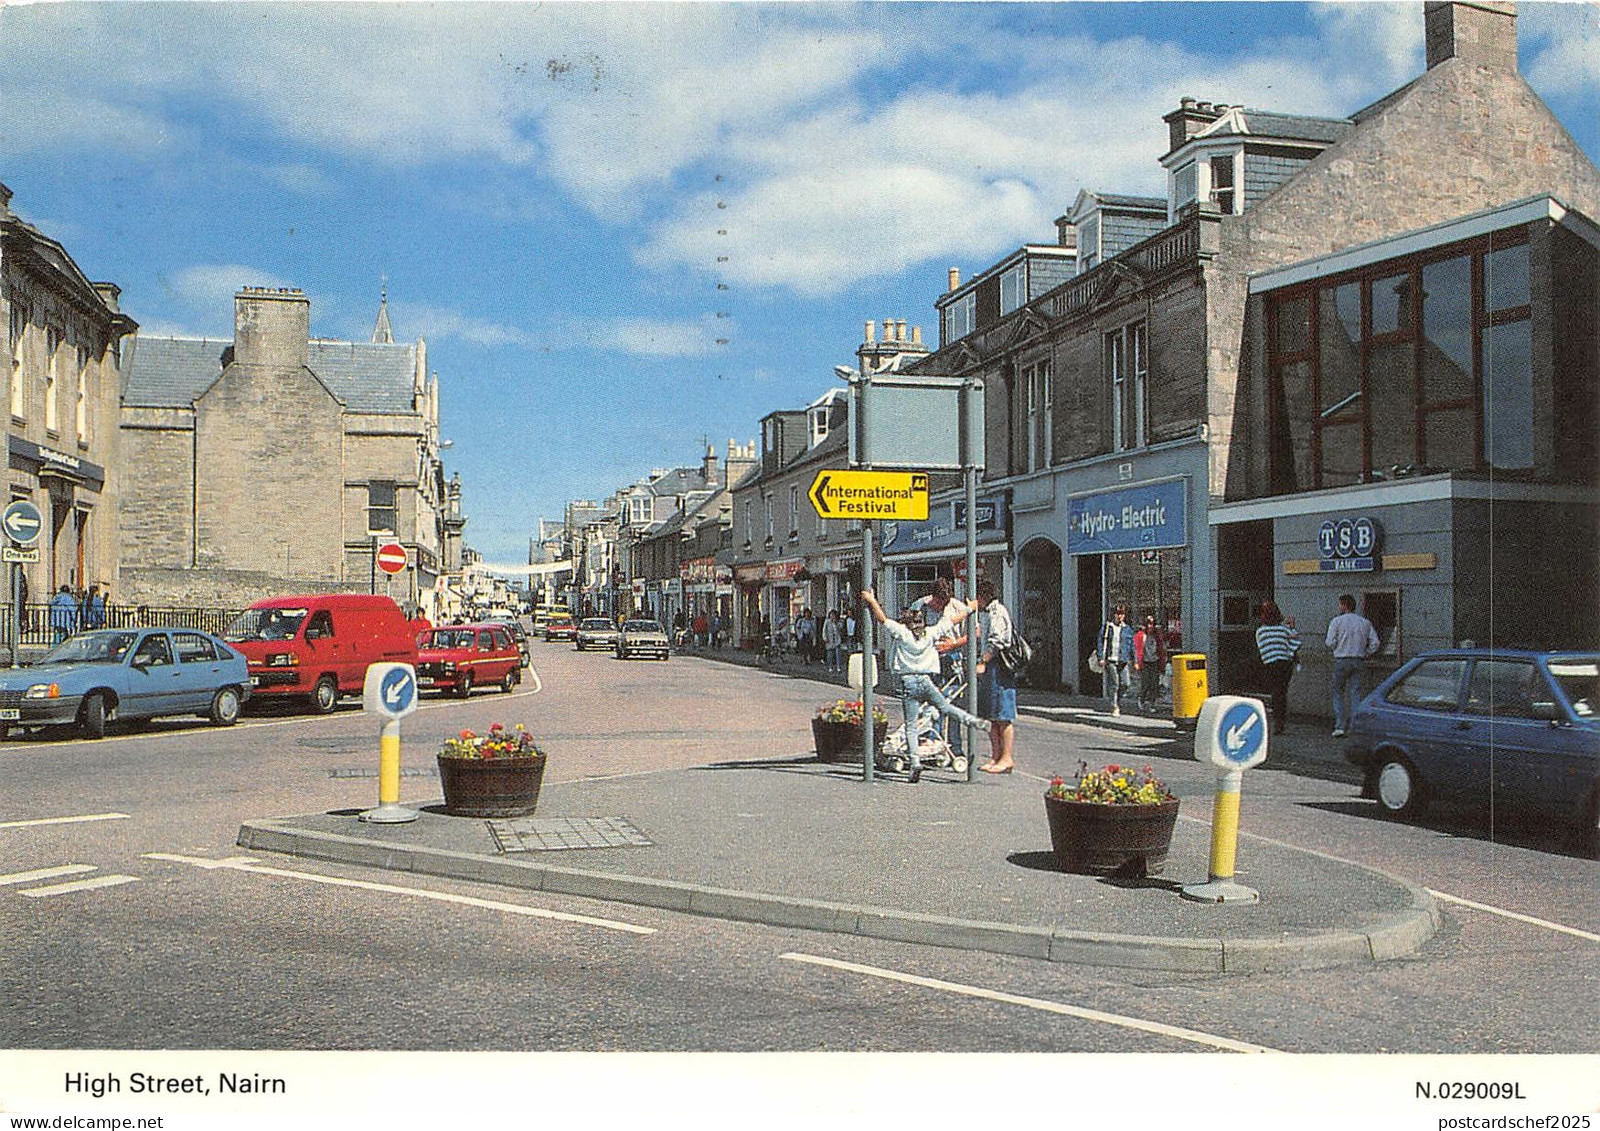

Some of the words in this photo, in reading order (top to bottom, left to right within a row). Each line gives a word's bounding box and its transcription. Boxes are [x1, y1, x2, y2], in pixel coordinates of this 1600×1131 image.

[826, 486, 914, 499] International
[839, 501, 897, 513] Festival
[1081, 499, 1166, 538] Hydro-Electric
[1320, 525, 1371, 551] TSB
[1335, 561, 1357, 570] BANK
